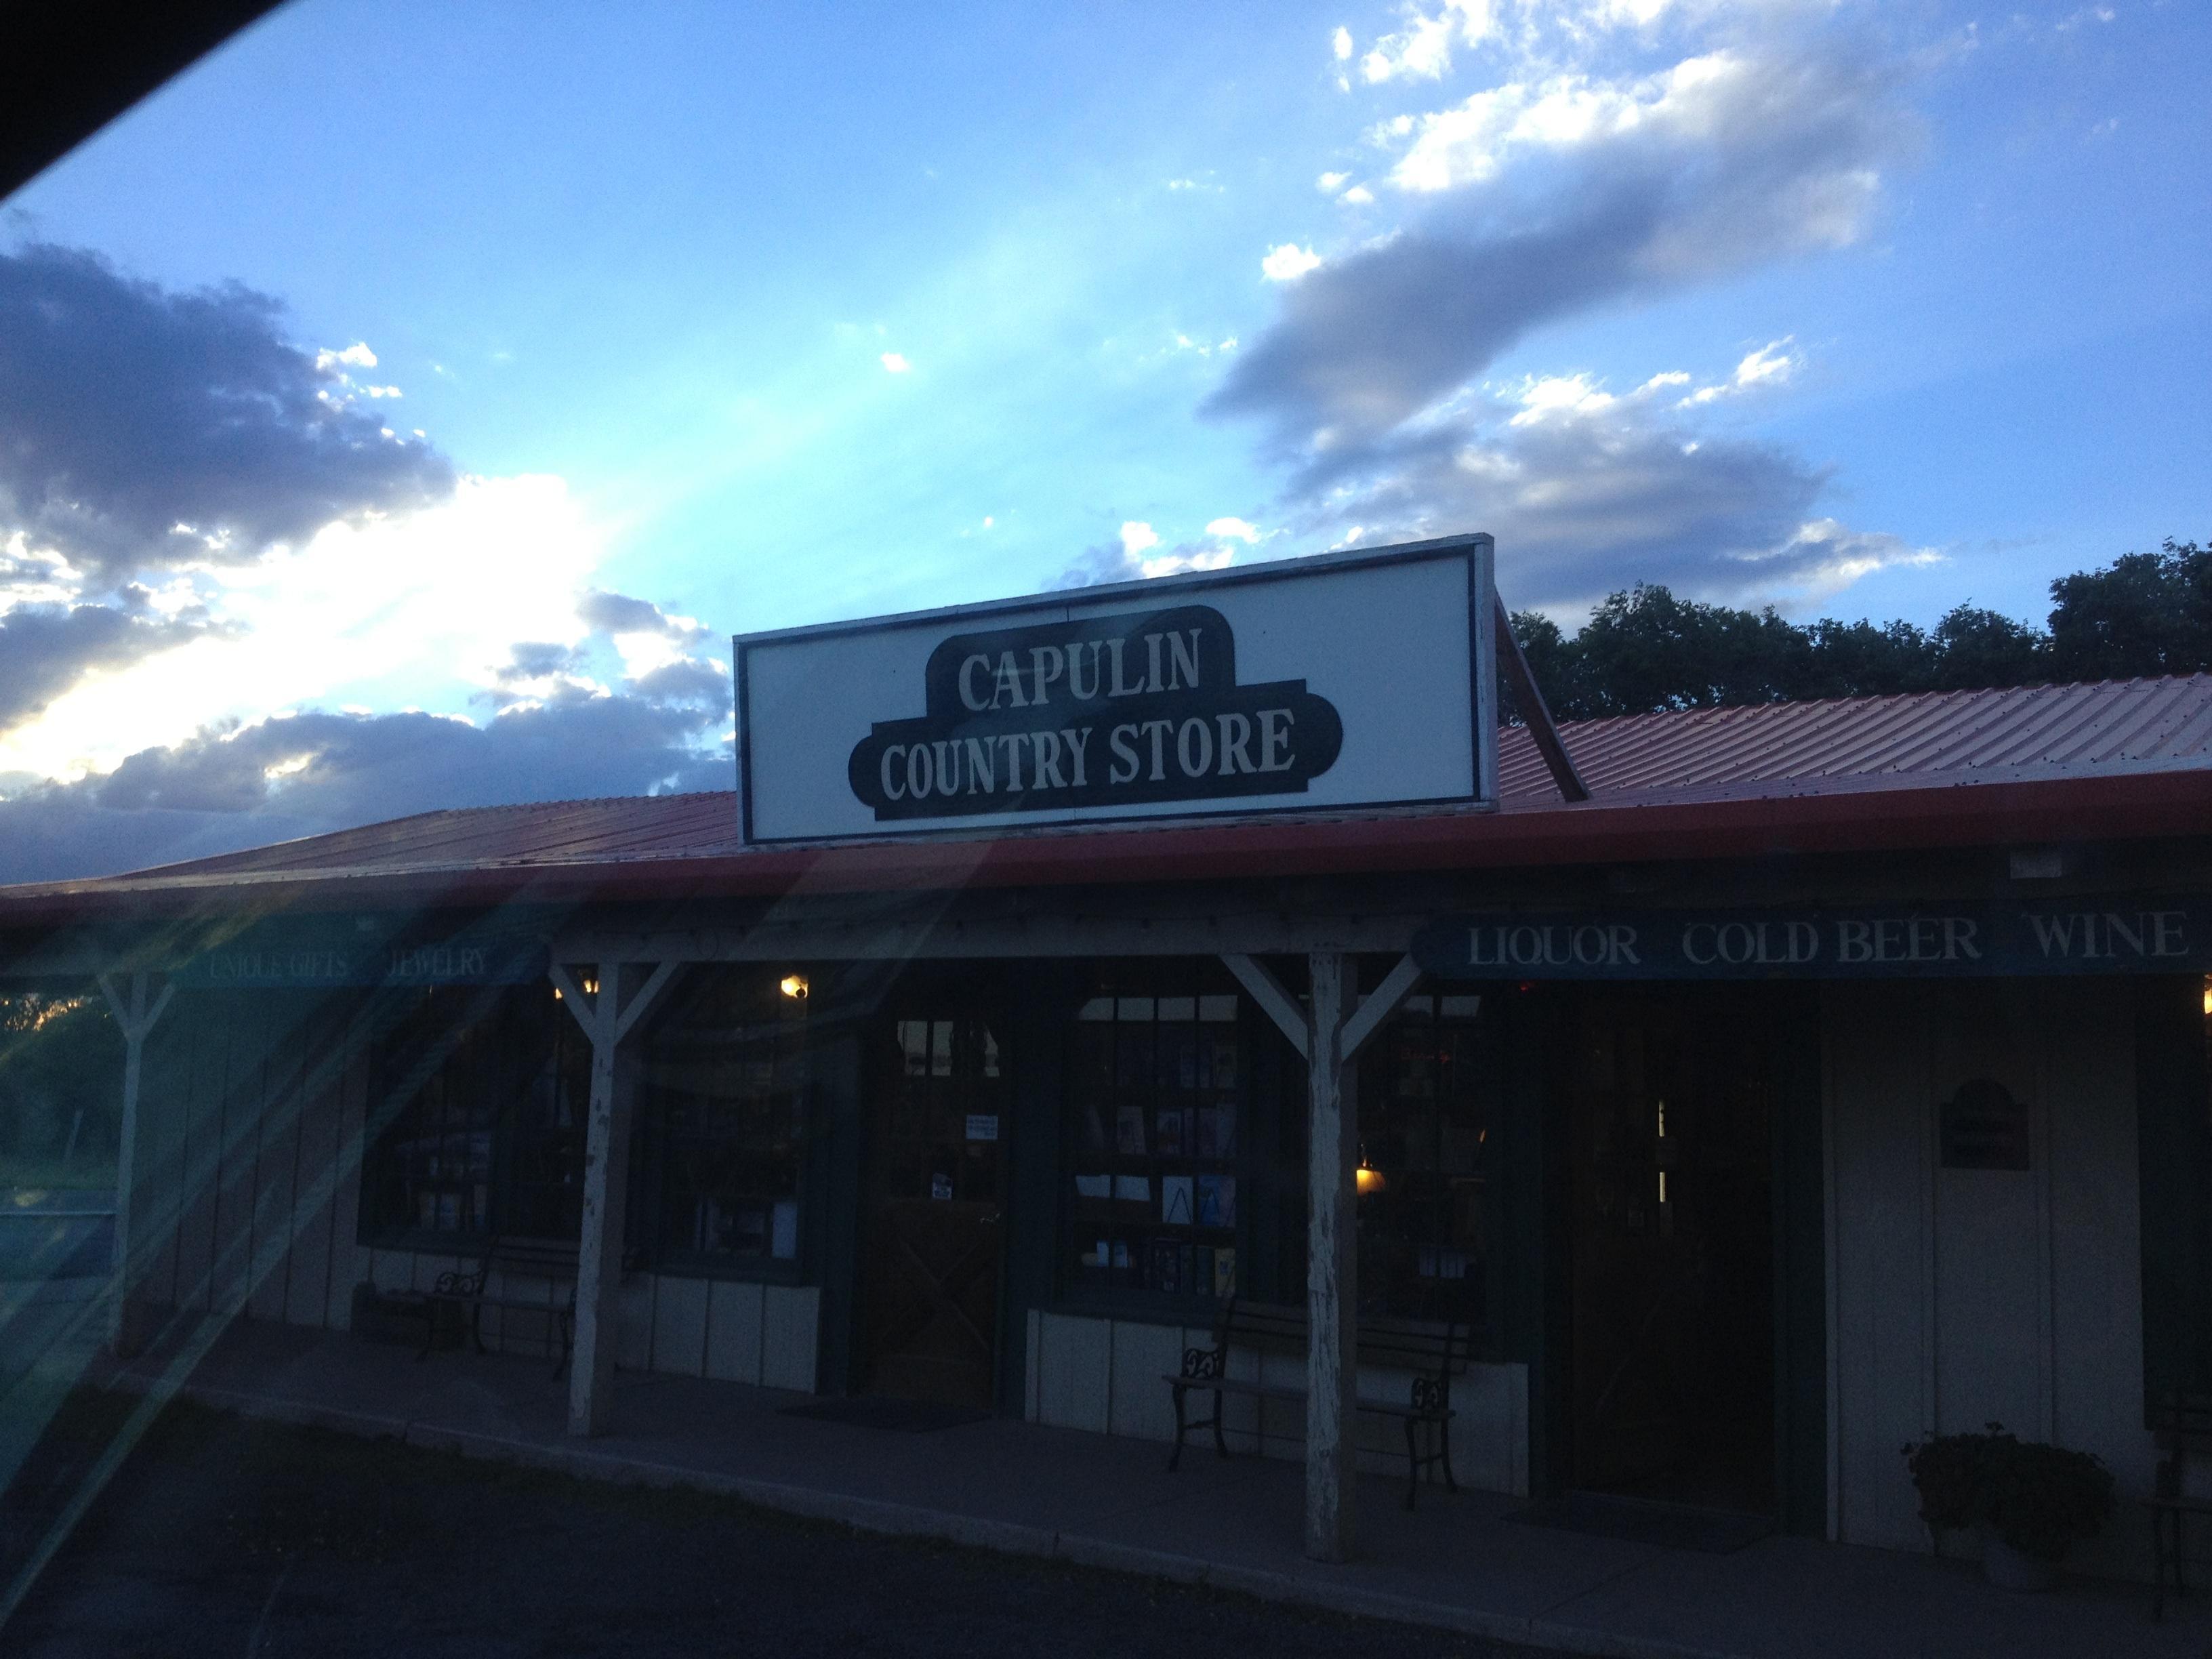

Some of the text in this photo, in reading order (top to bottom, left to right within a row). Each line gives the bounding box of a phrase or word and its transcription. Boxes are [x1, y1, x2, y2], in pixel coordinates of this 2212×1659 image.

[958, 628, 1204, 712] CAPULIN
[880, 708, 1296, 801] COUNTRY STORE
[289, 948, 347, 978] GIFTS
[385, 946, 488, 977] JEWELRY
[1467, 910, 2191, 966] LIQUOR COLD BEER WINE
